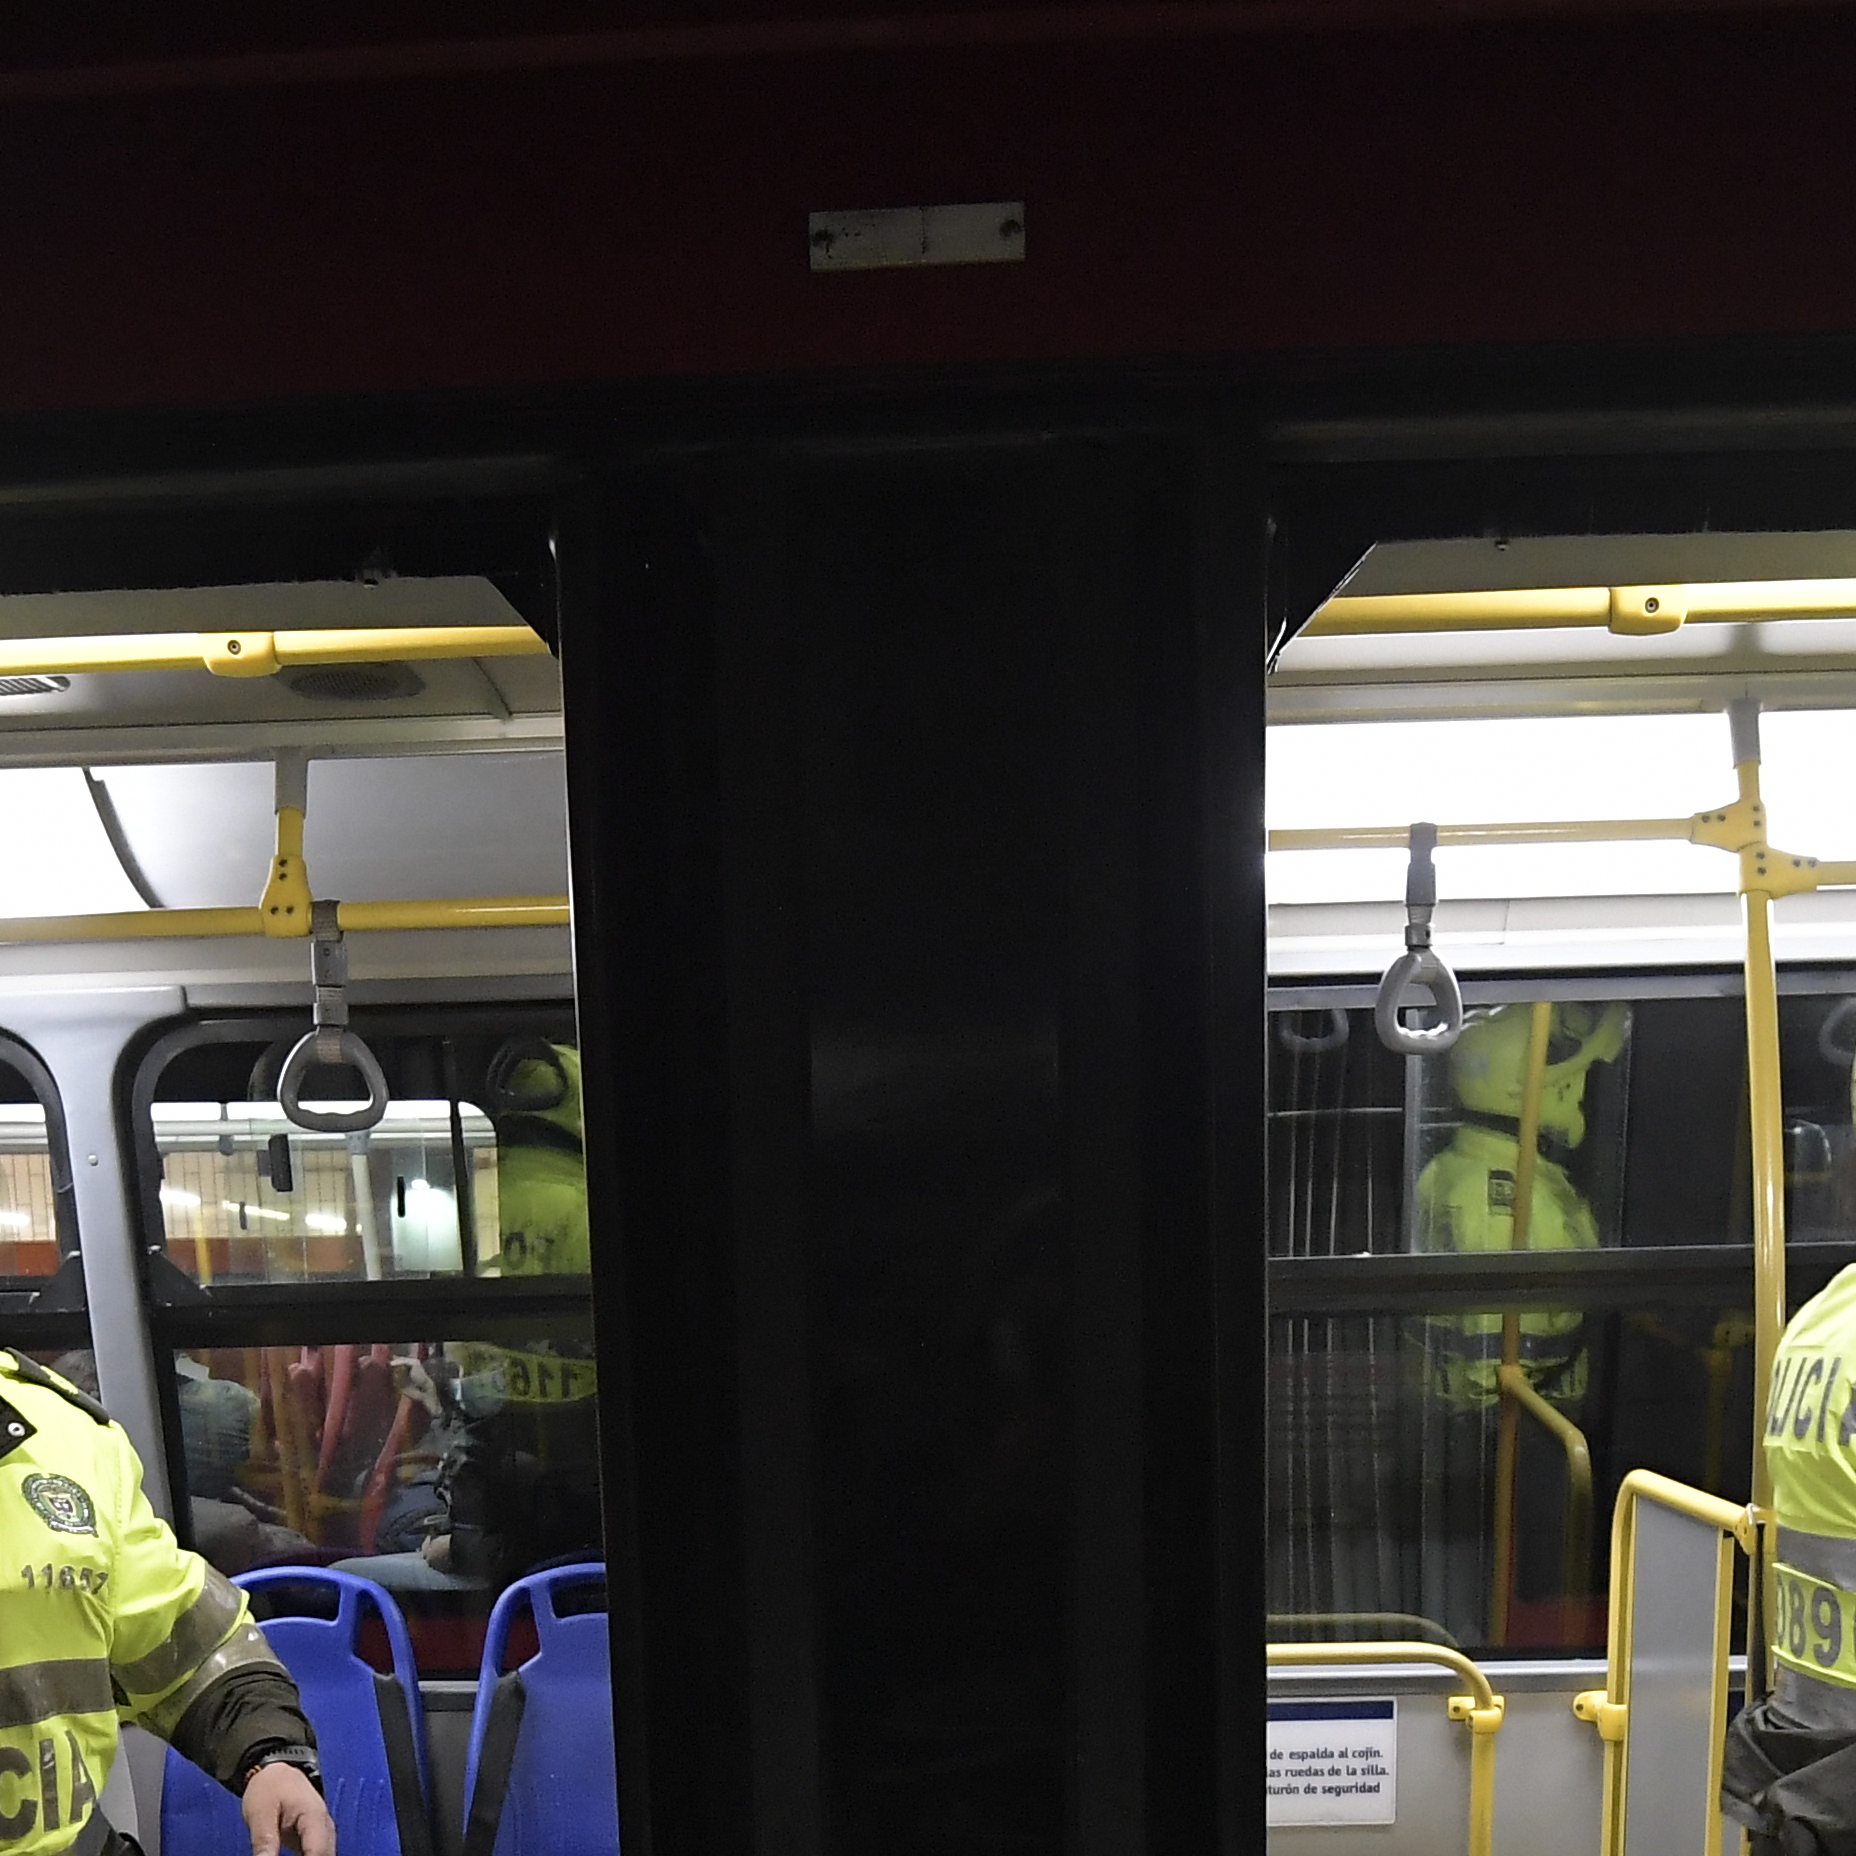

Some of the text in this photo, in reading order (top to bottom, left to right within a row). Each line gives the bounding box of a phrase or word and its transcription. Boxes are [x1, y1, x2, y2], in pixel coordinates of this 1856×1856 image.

[1269, 1748, 1284, 1760] de
[1288, 1747, 1335, 1762] espalda
[1337, 1746, 1349, 1759] al
[1284, 1765, 1325, 1777] ruedas
[1327, 1764, 1342, 1777] de
[1346, 1764, 1357, 1776] la
[1266, 1781, 1381, 1797] turón de seguridad
